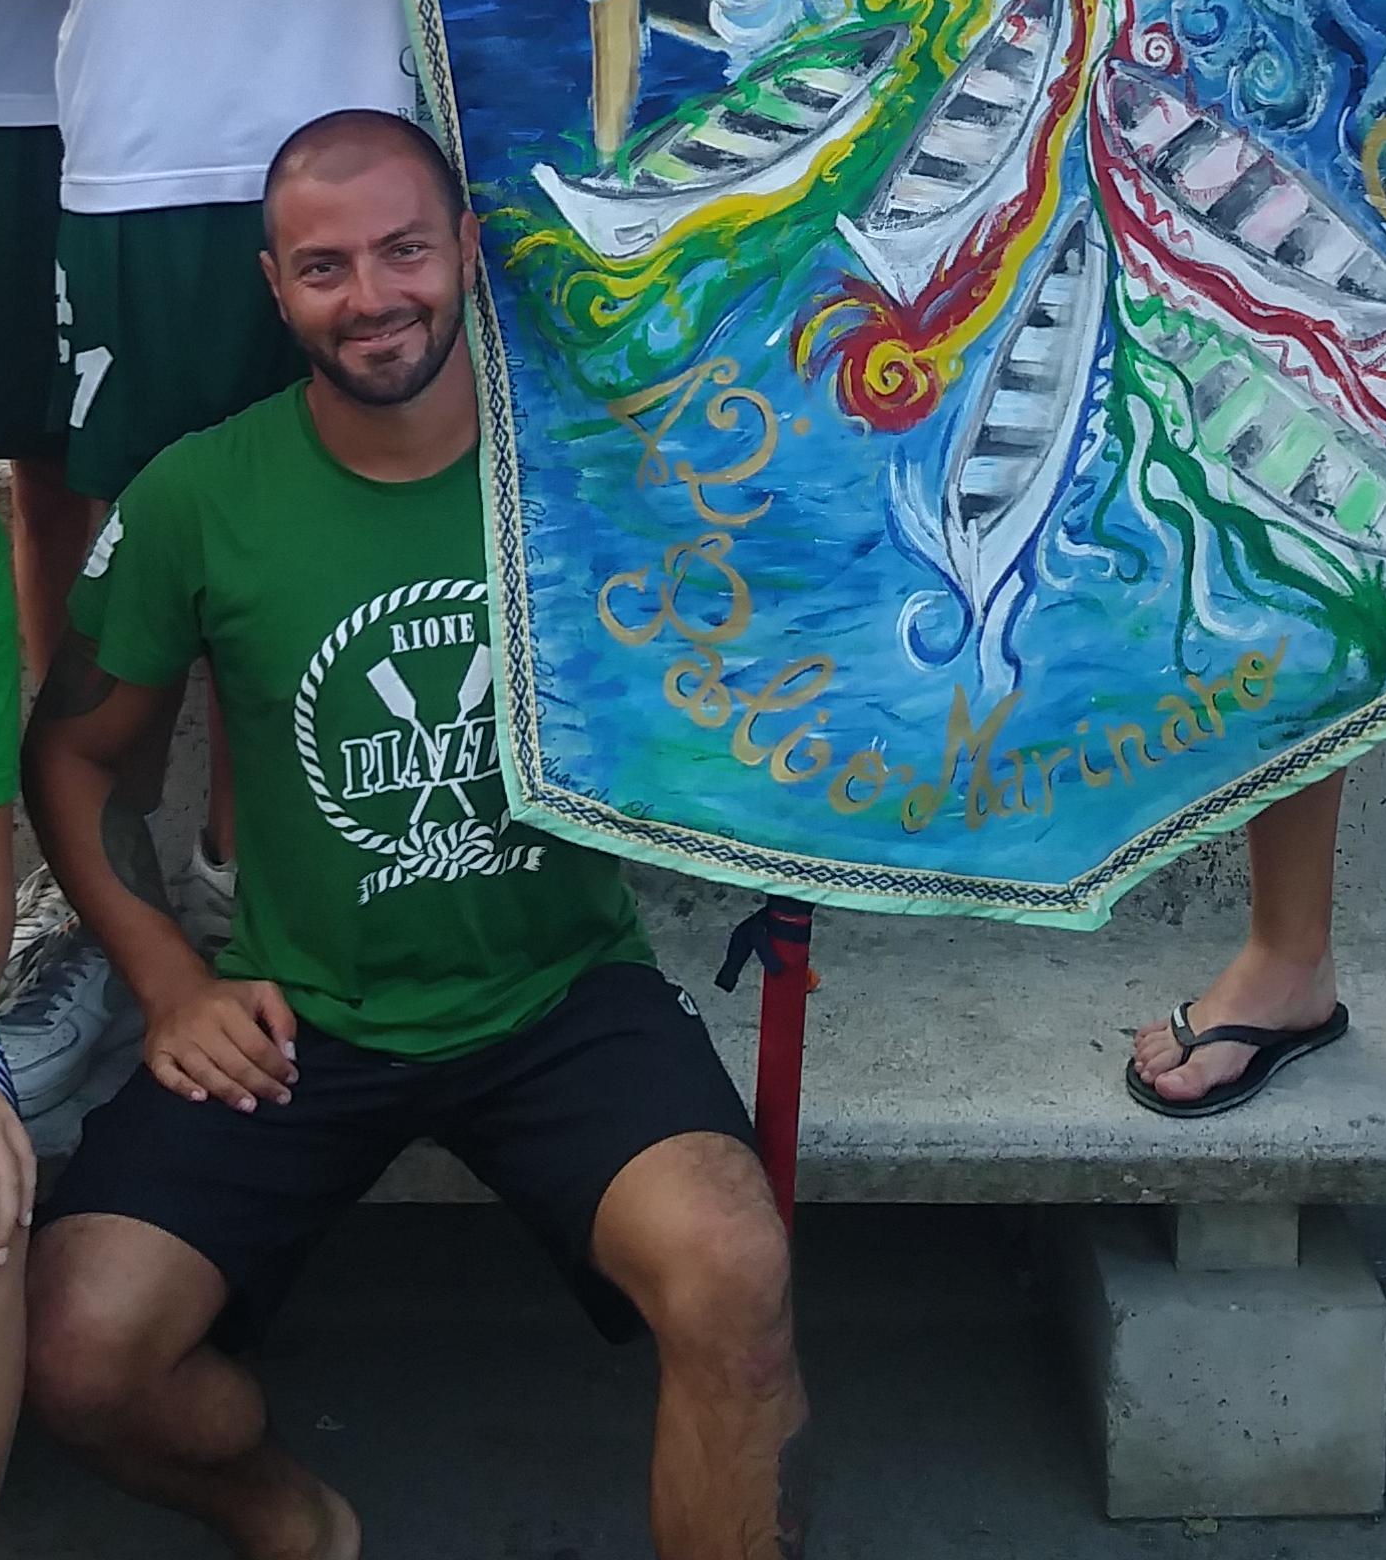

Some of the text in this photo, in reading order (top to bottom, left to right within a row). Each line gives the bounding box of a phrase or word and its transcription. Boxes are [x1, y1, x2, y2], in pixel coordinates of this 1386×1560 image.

[389, 612, 476, 654] RIONE
[340, 714, 503, 800] PIAZZ
[901, 633, 1293, 835] Marinaro
